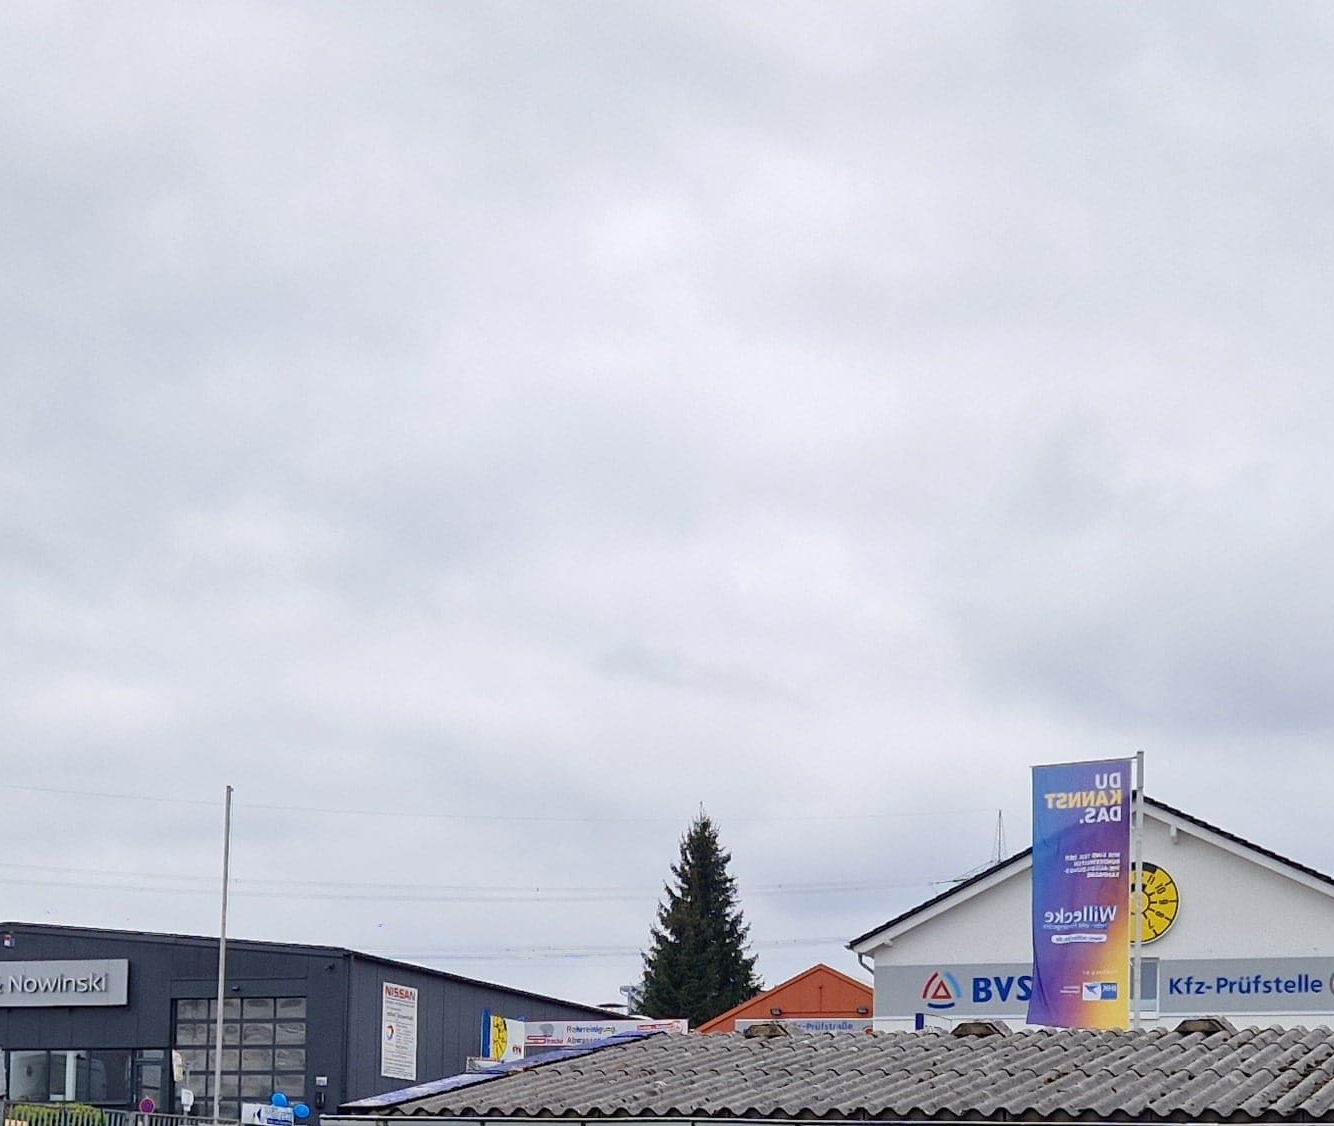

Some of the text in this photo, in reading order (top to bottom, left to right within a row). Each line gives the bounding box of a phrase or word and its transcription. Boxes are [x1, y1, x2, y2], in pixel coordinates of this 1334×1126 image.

[1155, 883, 1166, 894] 10
[8, 972, 109, 994] Nowinski
[385, 985, 416, 1001] NISSAN
[972, 976, 1033, 1002] BVS
[1169, 973, 1323, 996] Kfz-Prüfstelle
